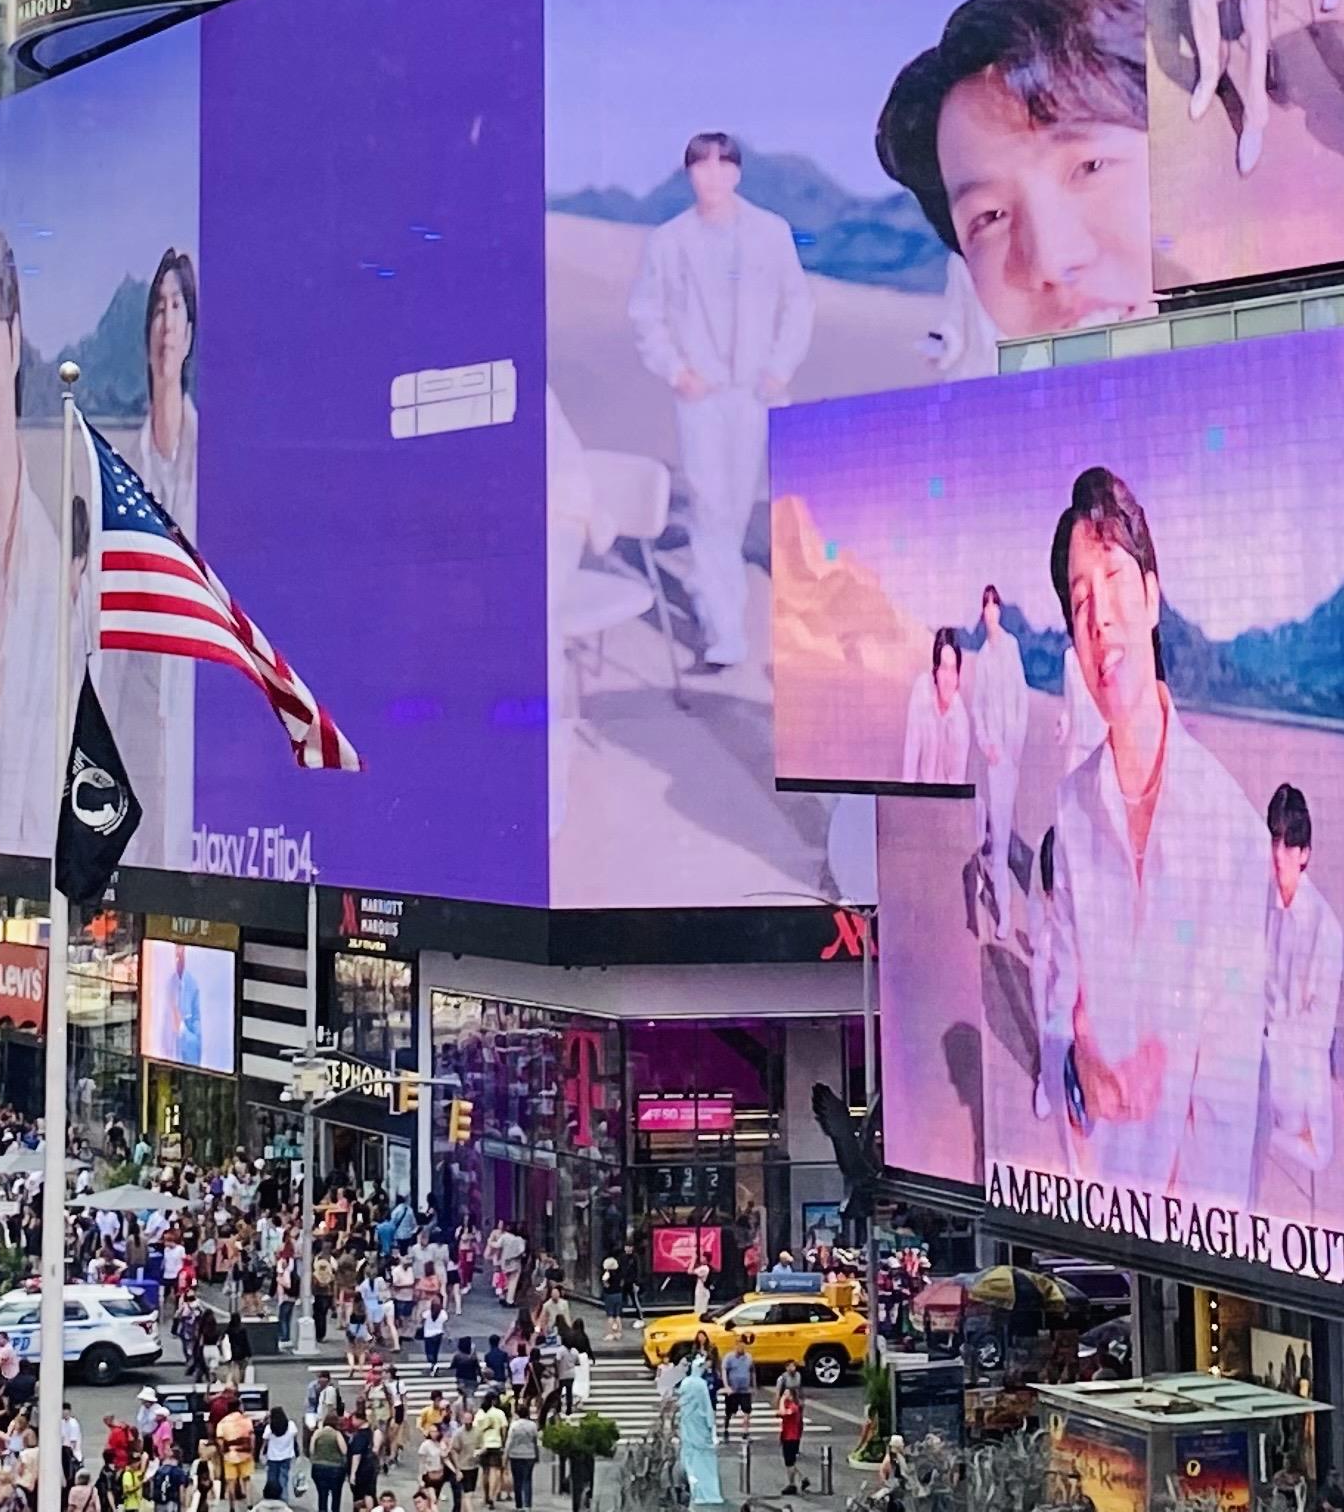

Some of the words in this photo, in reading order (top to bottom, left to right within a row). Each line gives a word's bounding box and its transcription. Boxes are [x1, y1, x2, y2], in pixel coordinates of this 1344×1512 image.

[247, 827, 259, 876] Z
[264, 824, 311, 882] Flip4
[987, 1162, 1152, 1240] AMERICAN
[1163, 1196, 1271, 1264] EAGLE
